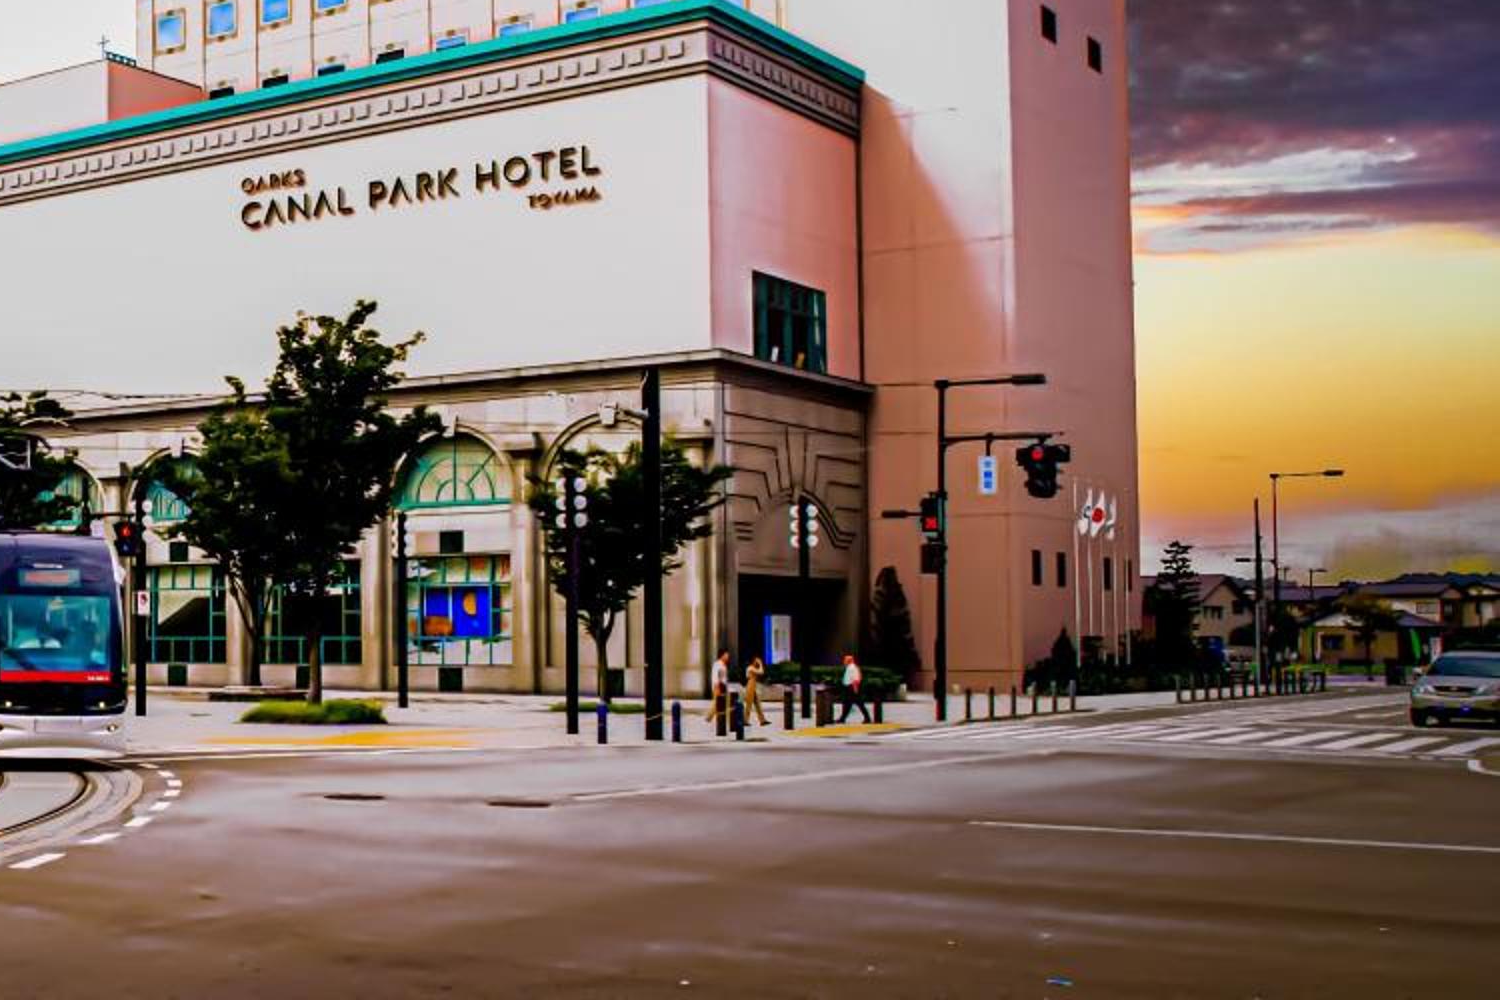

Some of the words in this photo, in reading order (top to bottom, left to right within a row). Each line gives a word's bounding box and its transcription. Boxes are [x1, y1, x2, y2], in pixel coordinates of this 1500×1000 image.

[241, 186, 355, 231] CANAL
[368, 167, 460, 209] PARK
[475, 144, 601, 193] HOTEL
